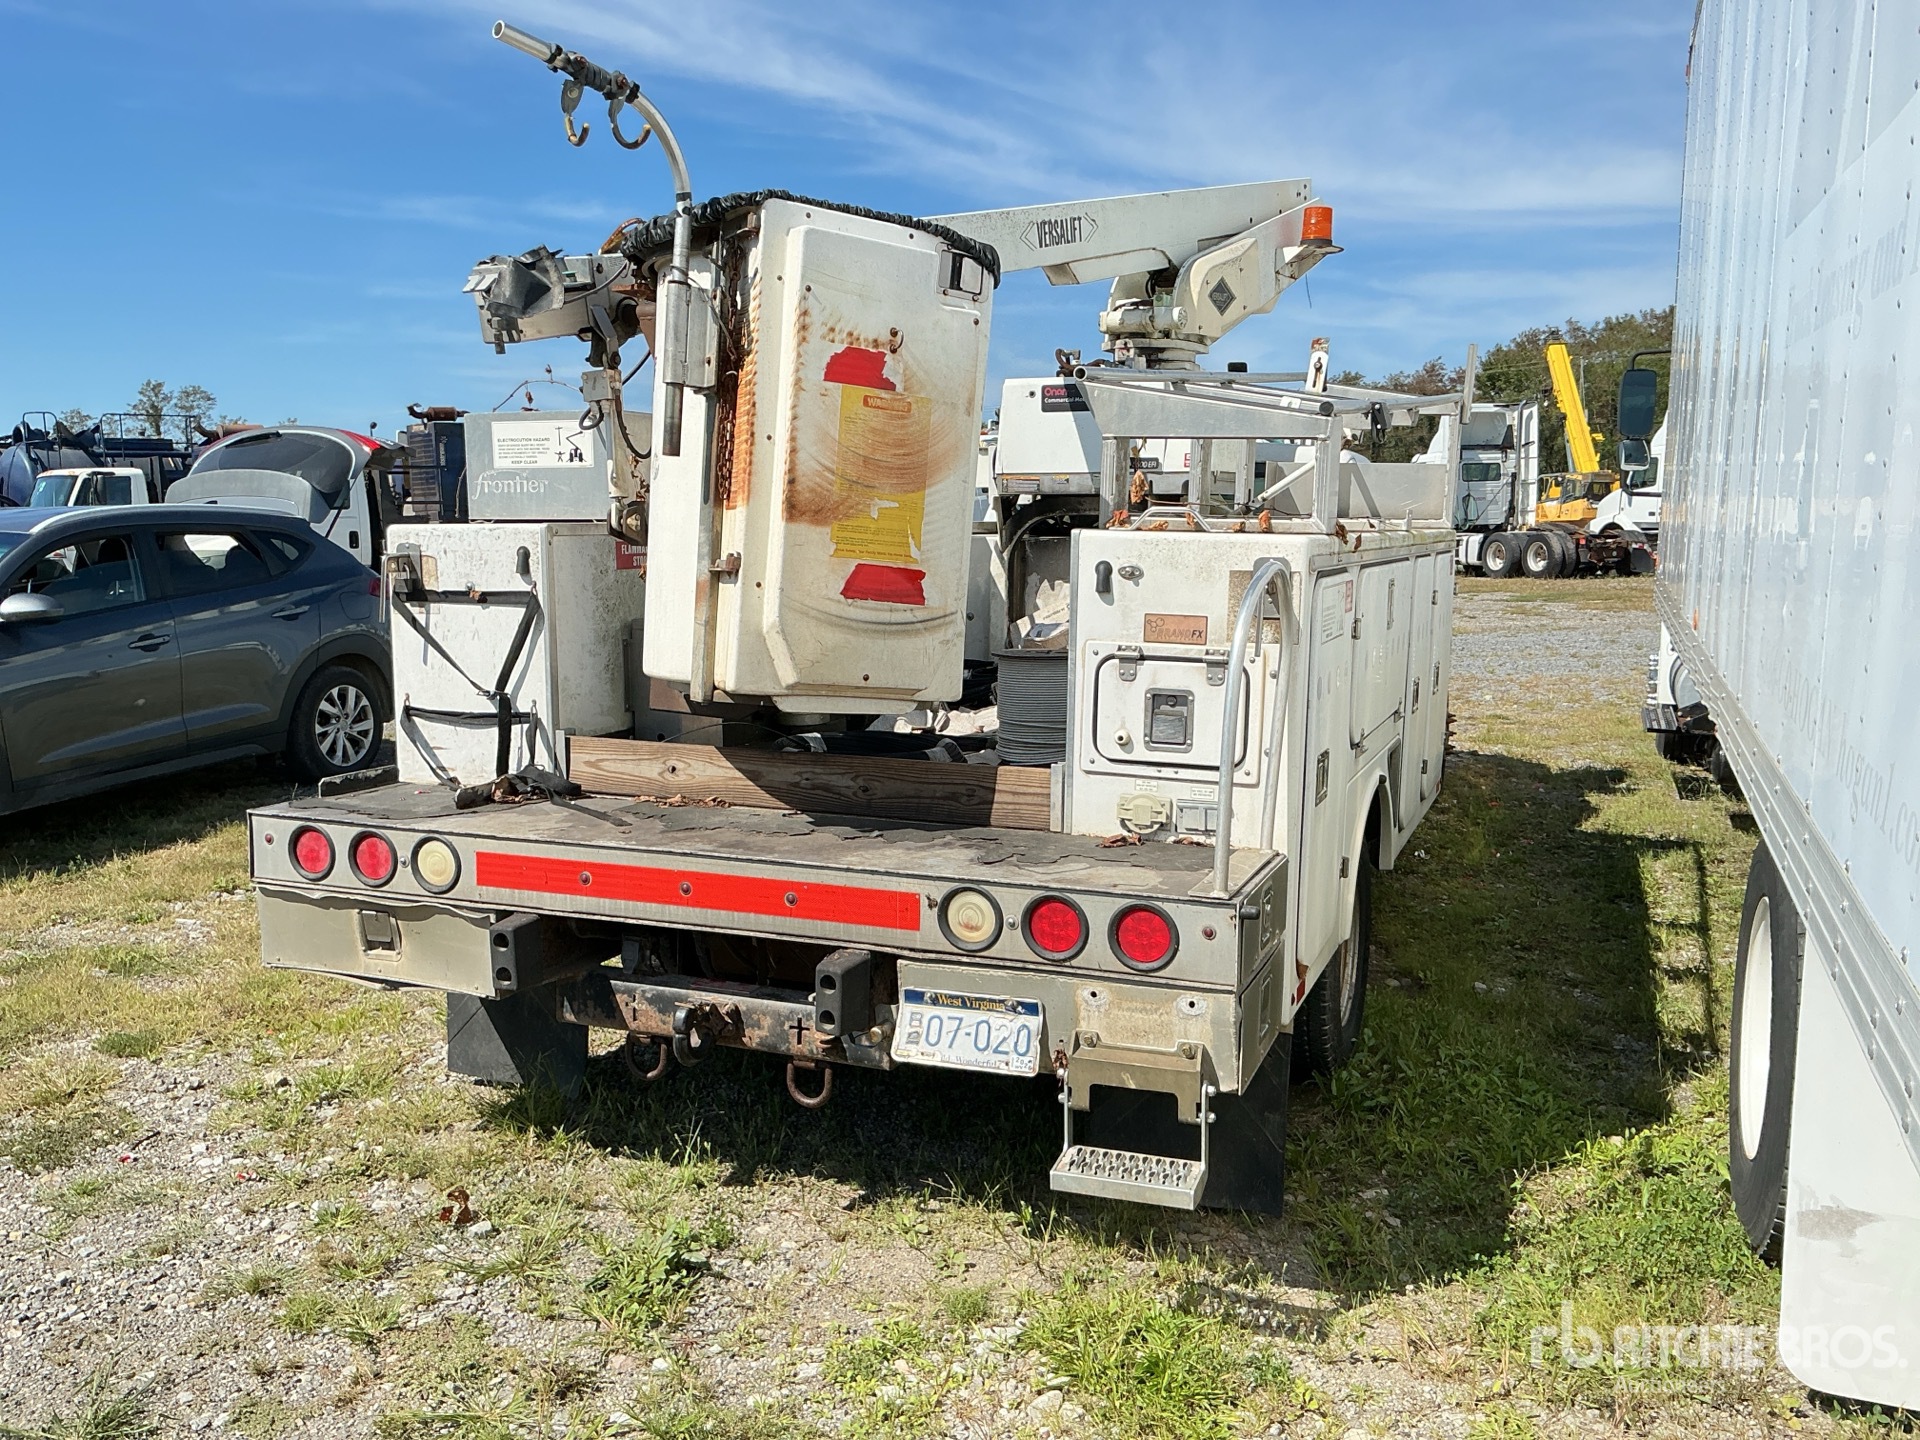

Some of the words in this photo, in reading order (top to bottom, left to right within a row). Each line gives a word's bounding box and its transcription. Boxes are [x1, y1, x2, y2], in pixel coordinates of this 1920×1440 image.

[1036, 216, 1083, 248] VERSALIFT
[1044, 387, 1068, 397] Onan
[867, 396, 909, 412] WARNING
[472, 471, 549, 500] frontier
[937, 993, 962, 1006] West
[965, 996, 1006, 1012] Virginia
[925, 1014, 1031, 1057] 07-020
[955, 1056, 998, 1068] Wonderful
